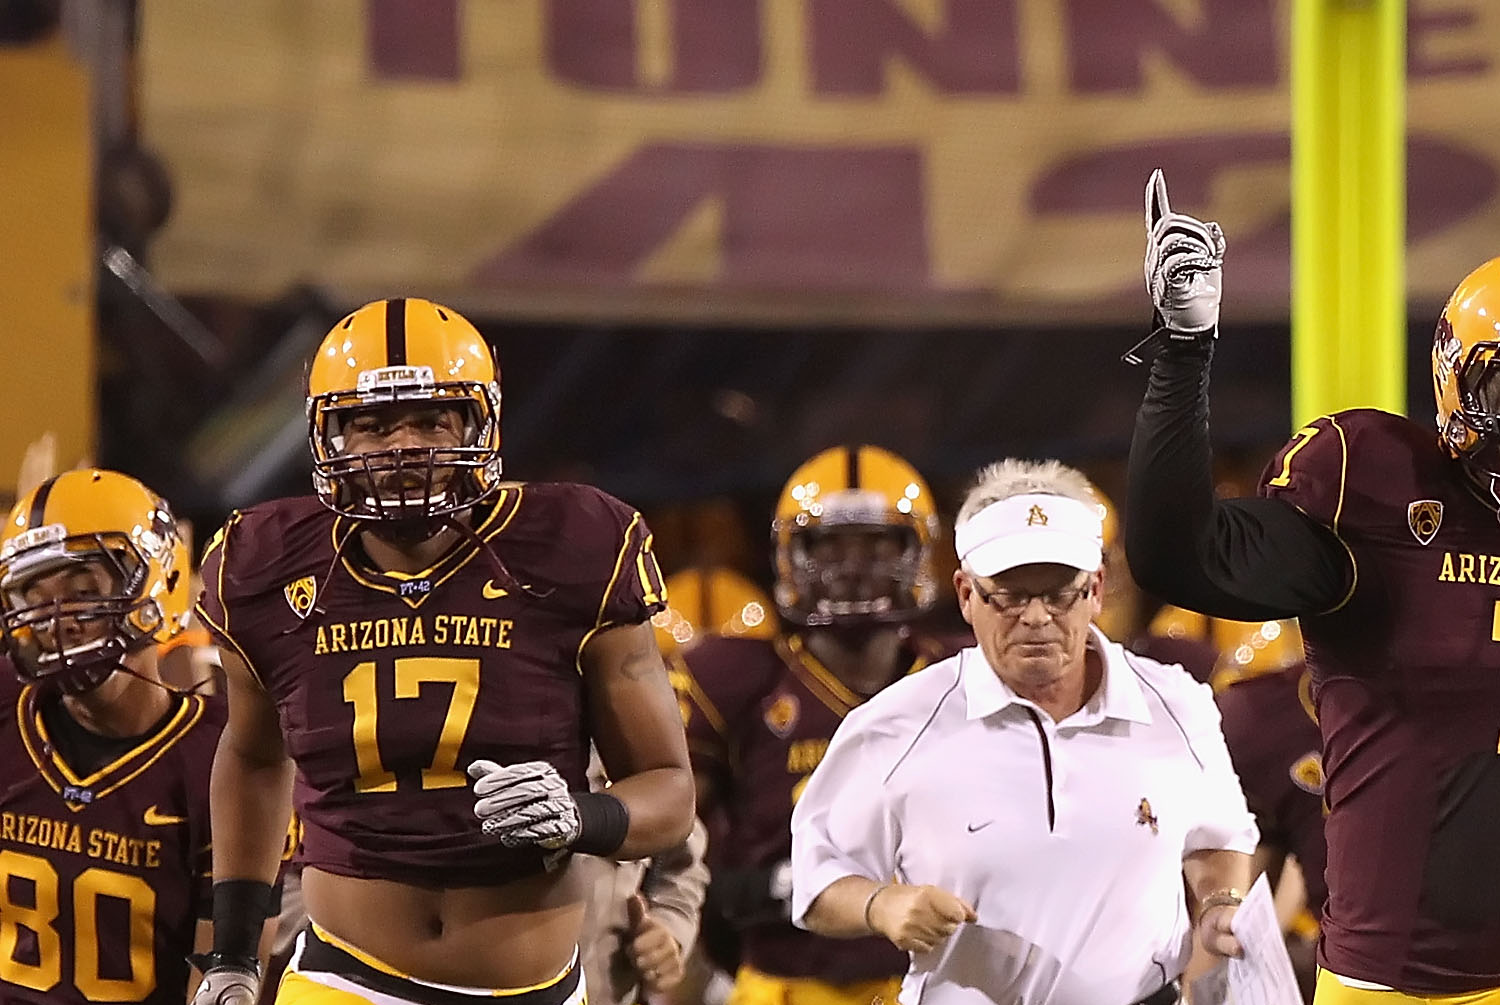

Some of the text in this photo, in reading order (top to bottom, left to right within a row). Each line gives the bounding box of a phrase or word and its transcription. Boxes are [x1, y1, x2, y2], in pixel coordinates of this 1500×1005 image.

[314, 614, 514, 655] ARIZONA STATE
[342, 656, 481, 793] 17
[0, 811, 161, 868] RIZONA STATE
[0, 849, 156, 1002] 80
